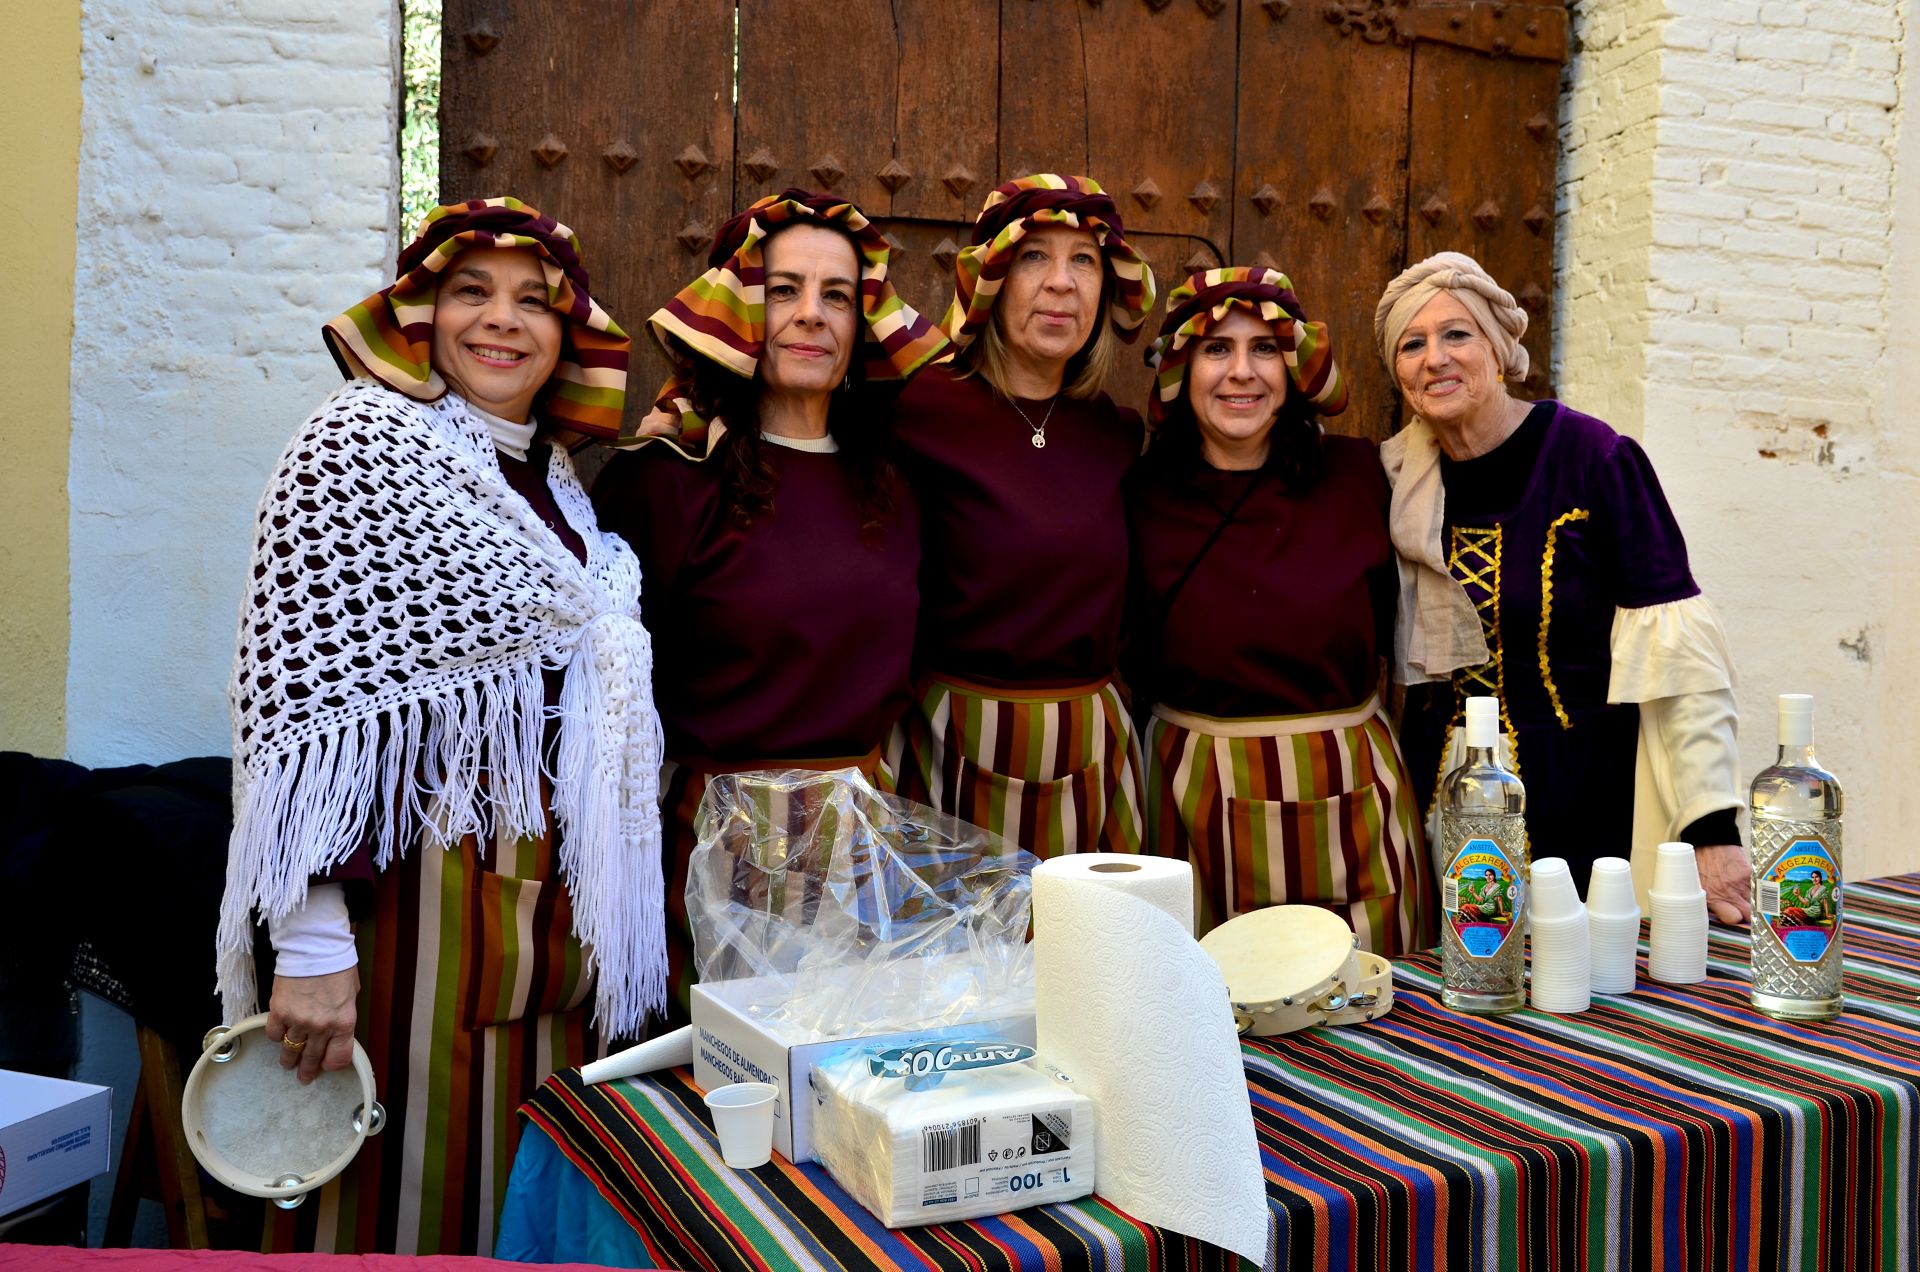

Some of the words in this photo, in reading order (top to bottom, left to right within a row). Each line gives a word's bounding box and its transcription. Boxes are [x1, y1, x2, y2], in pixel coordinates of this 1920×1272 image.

[699, 1026, 732, 1060] MANCHEGOS
[732, 1050, 740, 1066] DE
[700, 1047, 733, 1081] MANCHEGOS
[1010, 1172, 1044, 1192] 100
[1063, 1167, 1071, 1183] 1
